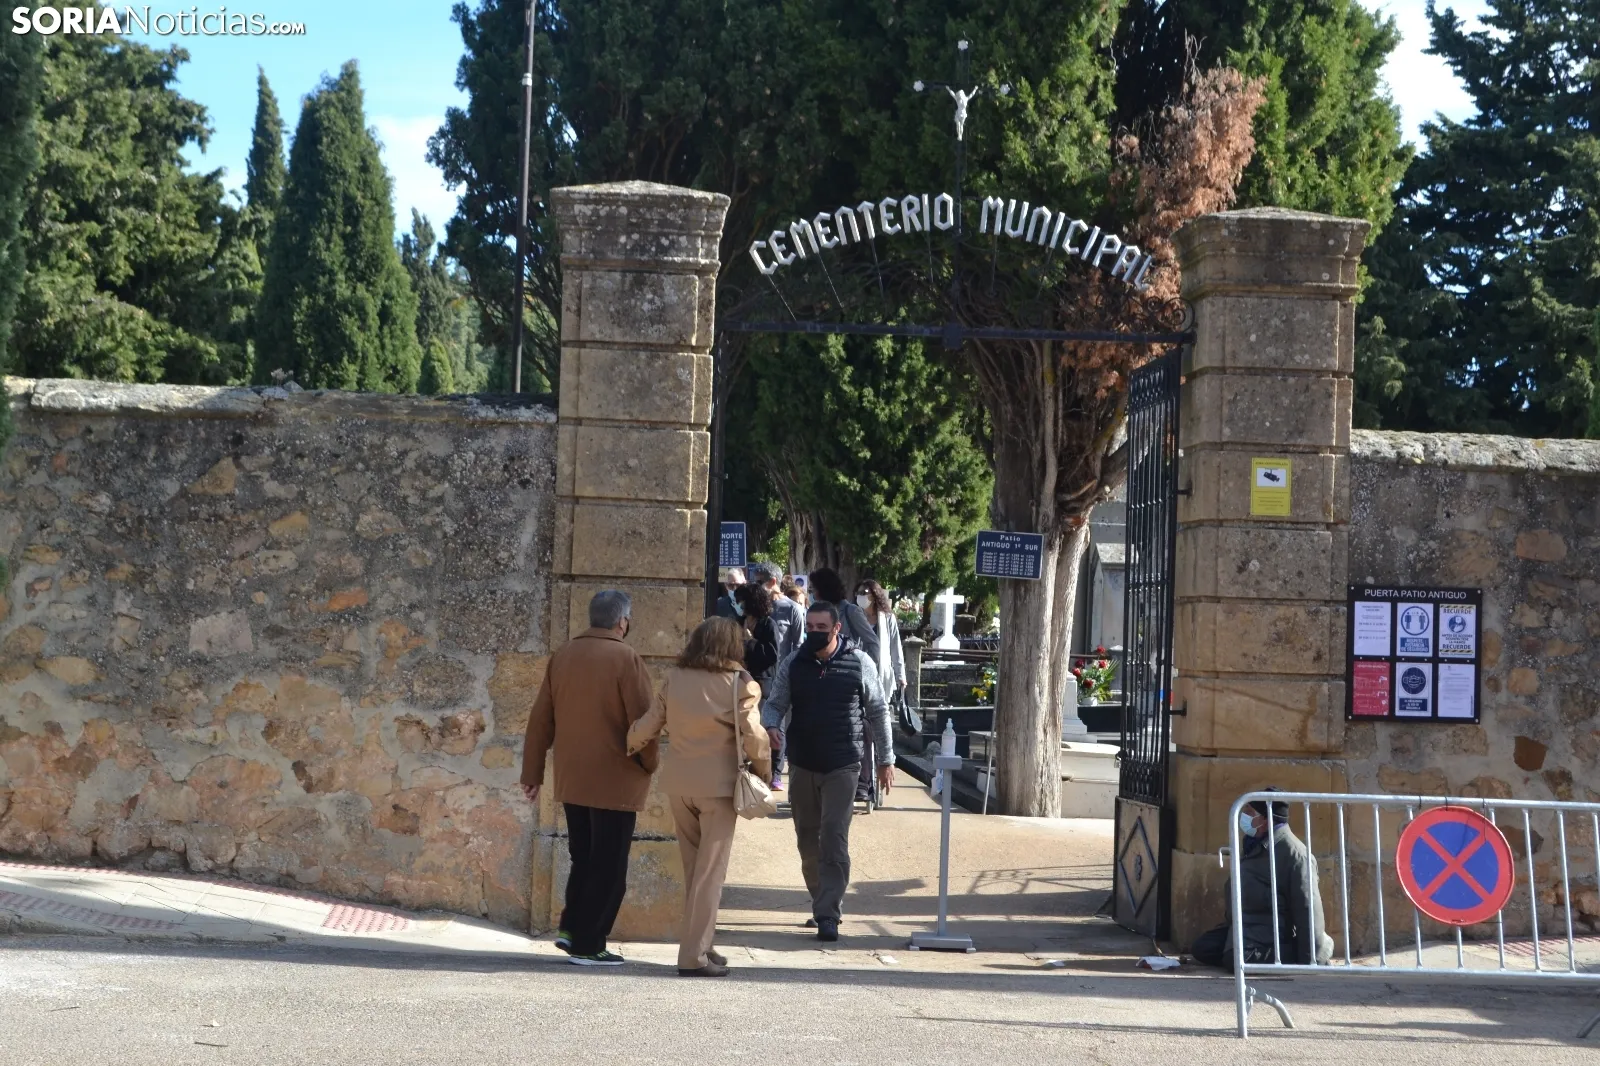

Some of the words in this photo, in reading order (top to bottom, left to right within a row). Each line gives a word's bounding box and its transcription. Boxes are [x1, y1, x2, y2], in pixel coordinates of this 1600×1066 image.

[749, 192, 954, 275] CEMENTERIO
[979, 195, 1152, 291] MUNICIPAL
[1364, 589, 1399, 597] PUERTA
[1401, 590, 1426, 598] PATIO
[1428, 591, 1467, 599] ANTIGUO
